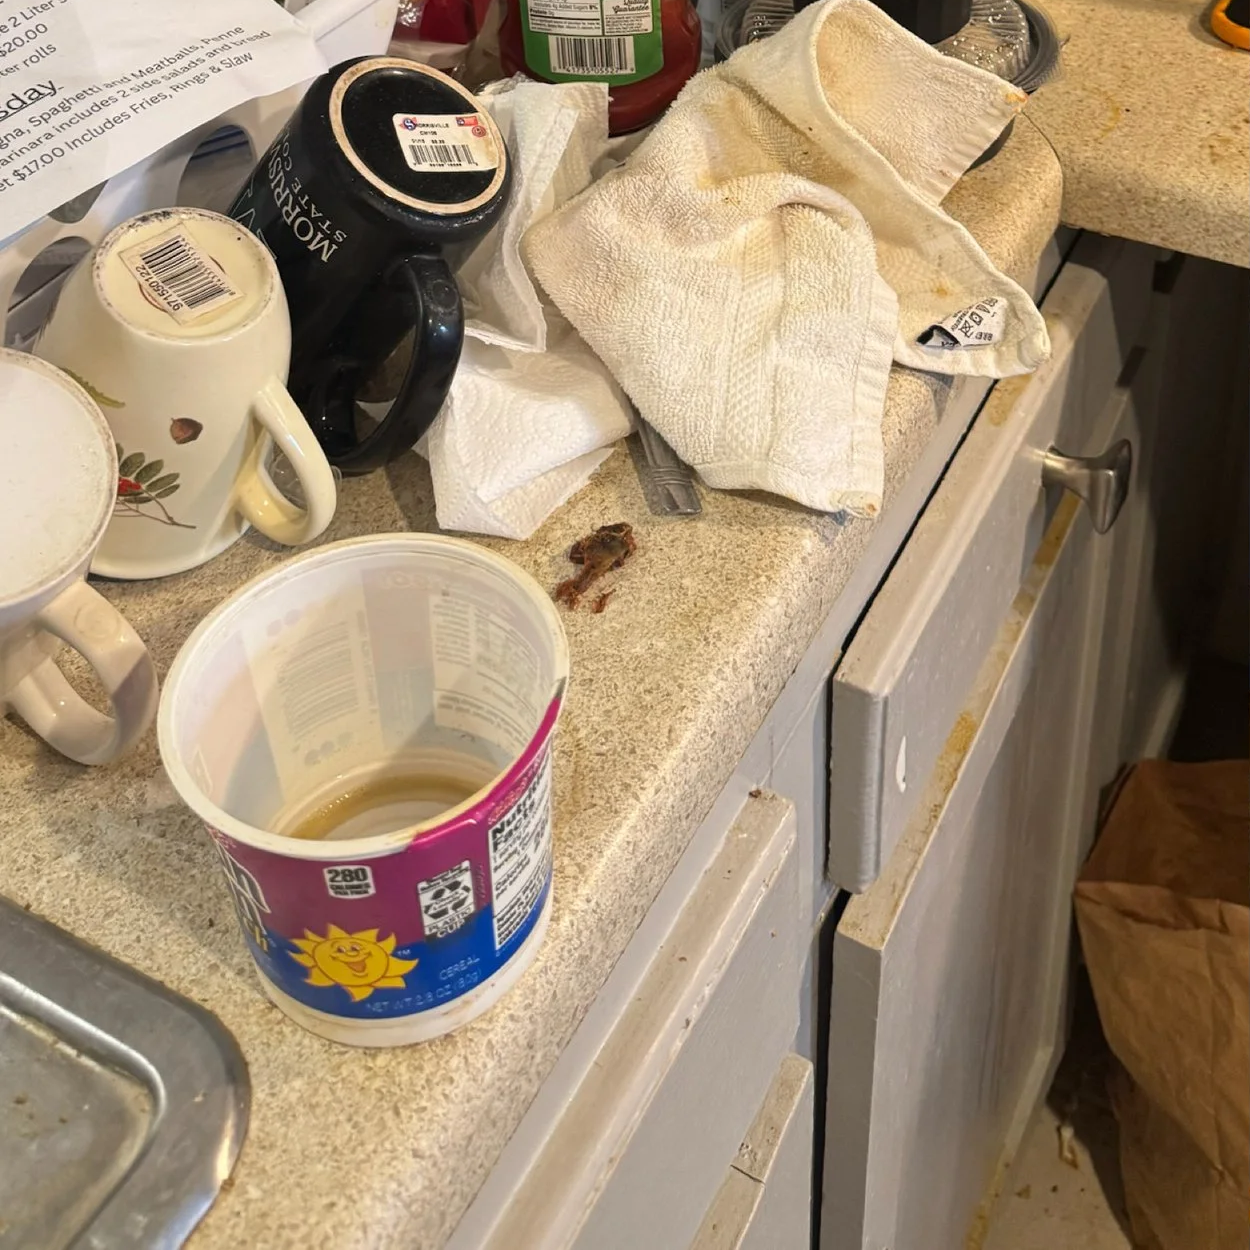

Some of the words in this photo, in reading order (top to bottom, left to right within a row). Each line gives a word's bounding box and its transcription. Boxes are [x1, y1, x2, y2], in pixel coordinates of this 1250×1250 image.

[8, 16, 21, 28] 2
[20, 0, 56, 21] Liter
[0, 23, 48, 57] $20.00
[23, 43, 57, 68] rolls
[28, 84, 103, 128] Spaghetti
[103, 76, 131, 89] and
[131, 44, 204, 80] Meatballs,
[201, 26, 245, 46] Penne
[54, 94, 119, 134] includes
[117, 89, 131, 98] 2
[129, 78, 161, 94] side
[161, 57, 206, 81] salads
[205, 43, 232, 59] and
[231, 30, 272, 47] bread
[12, 146, 66, 182] $17.00
[65, 110, 131, 151] Includes
[129, 91, 173, 115] Fries,
[169, 72, 210, 93] Rings
[209, 65, 222, 74] &
[219, 52, 254, 69] Slaw
[291, 177, 348, 243] STATE
[327, 867, 369, 884] 280
[436, 918, 466, 938] CUP
[439, 953, 481, 981] CEREAL
